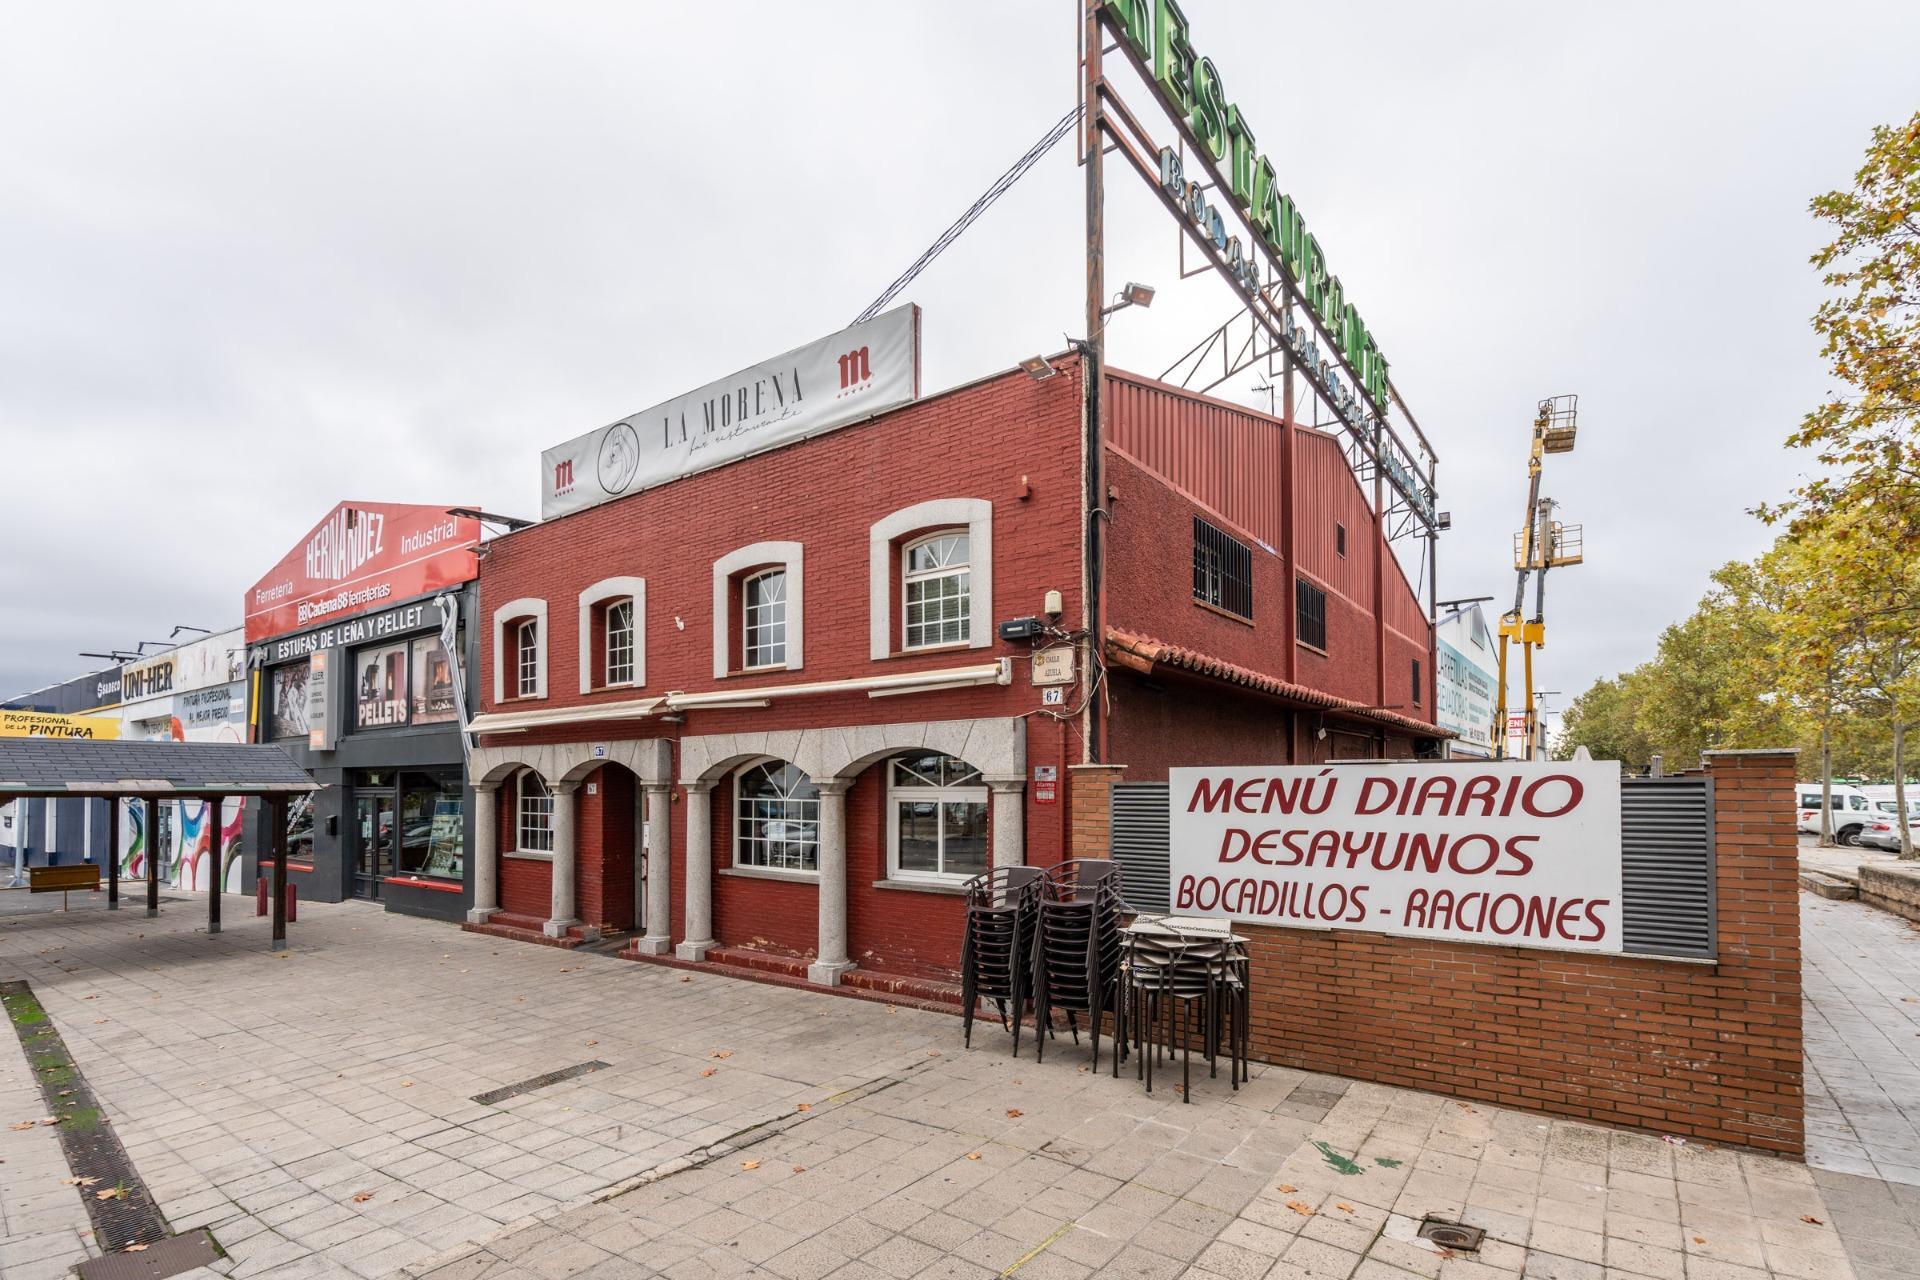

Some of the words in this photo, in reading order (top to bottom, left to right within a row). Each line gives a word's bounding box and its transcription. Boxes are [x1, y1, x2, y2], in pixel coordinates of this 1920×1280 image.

[1160, 145, 1260, 300] BODAS
[664, 412, 688, 449] LA
[703, 366, 803, 435] MORENA
[401, 516, 458, 555] Industrial
[278, 633, 317, 659] ESTUFAS
[320, 629, 334, 649] DE
[337, 616, 364, 642] LEÑA
[368, 615, 376, 638] Y
[378, 606, 423, 632] PELLET
[124, 661, 173, 700] UNI-HER
[1046, 690, 1059, 701] 67
[4, 714, 73, 725] PROFESIONAL
[30, 725, 93, 738] PINTURA
[359, 698, 407, 727] PELLETS
[1187, 767, 1338, 815] MENÚ
[1355, 774, 1585, 819] DIARIO
[1218, 828, 1541, 877] DESAYUNOS
[1176, 874, 1370, 923] BOCADILLOS
[1403, 887, 1611, 942] RACIONES
